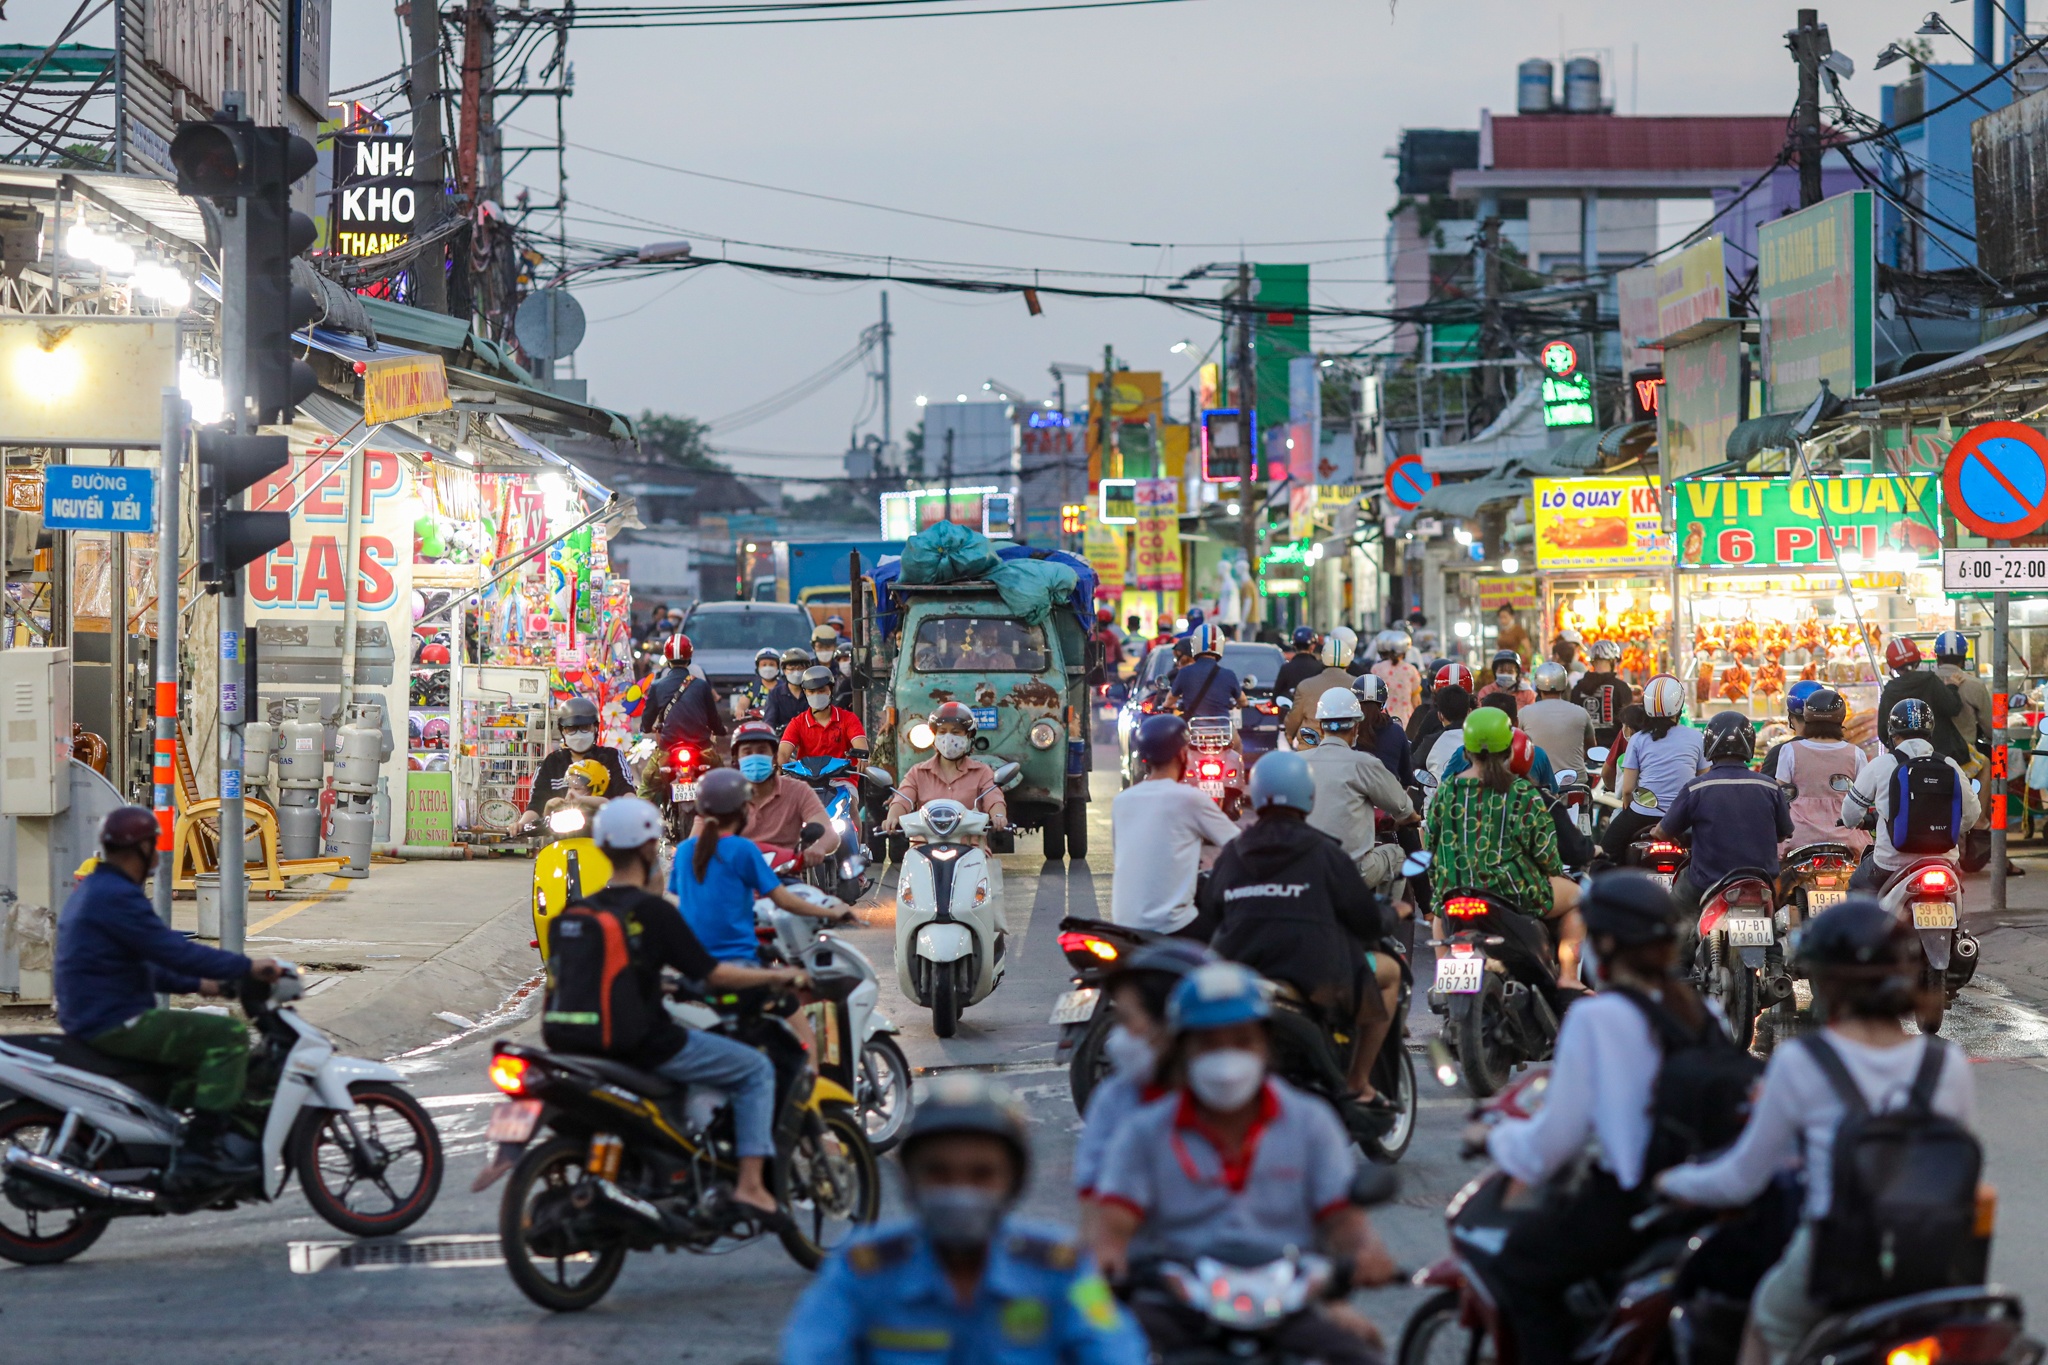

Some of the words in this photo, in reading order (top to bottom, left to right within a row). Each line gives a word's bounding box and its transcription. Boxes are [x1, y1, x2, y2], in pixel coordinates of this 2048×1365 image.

[72, 473, 127, 491] ĐƯỜNG
[52, 494, 103, 519] NGUYỄN
[111, 493, 140, 520] XIỂN
[1541, 487, 1566, 508] LÒ
[1572, 490, 1622, 508] QUAY
[1686, 481, 1770, 525] VỊT
[1788, 477, 1929, 520] QUAY
[1718, 528, 1755, 563] 6
[249, 536, 398, 611] GAS
[418, 789, 448, 812] KHOA
[426, 829, 449, 841] SINH
[1919, 904, 1948, 915] 59-B1
[1736, 920, 1765, 931] 17-B1
[1732, 932, 1770, 944] 238.04
[1444, 962, 1474, 975] 50-X1
[1438, 976, 1477, 990] 067.31
